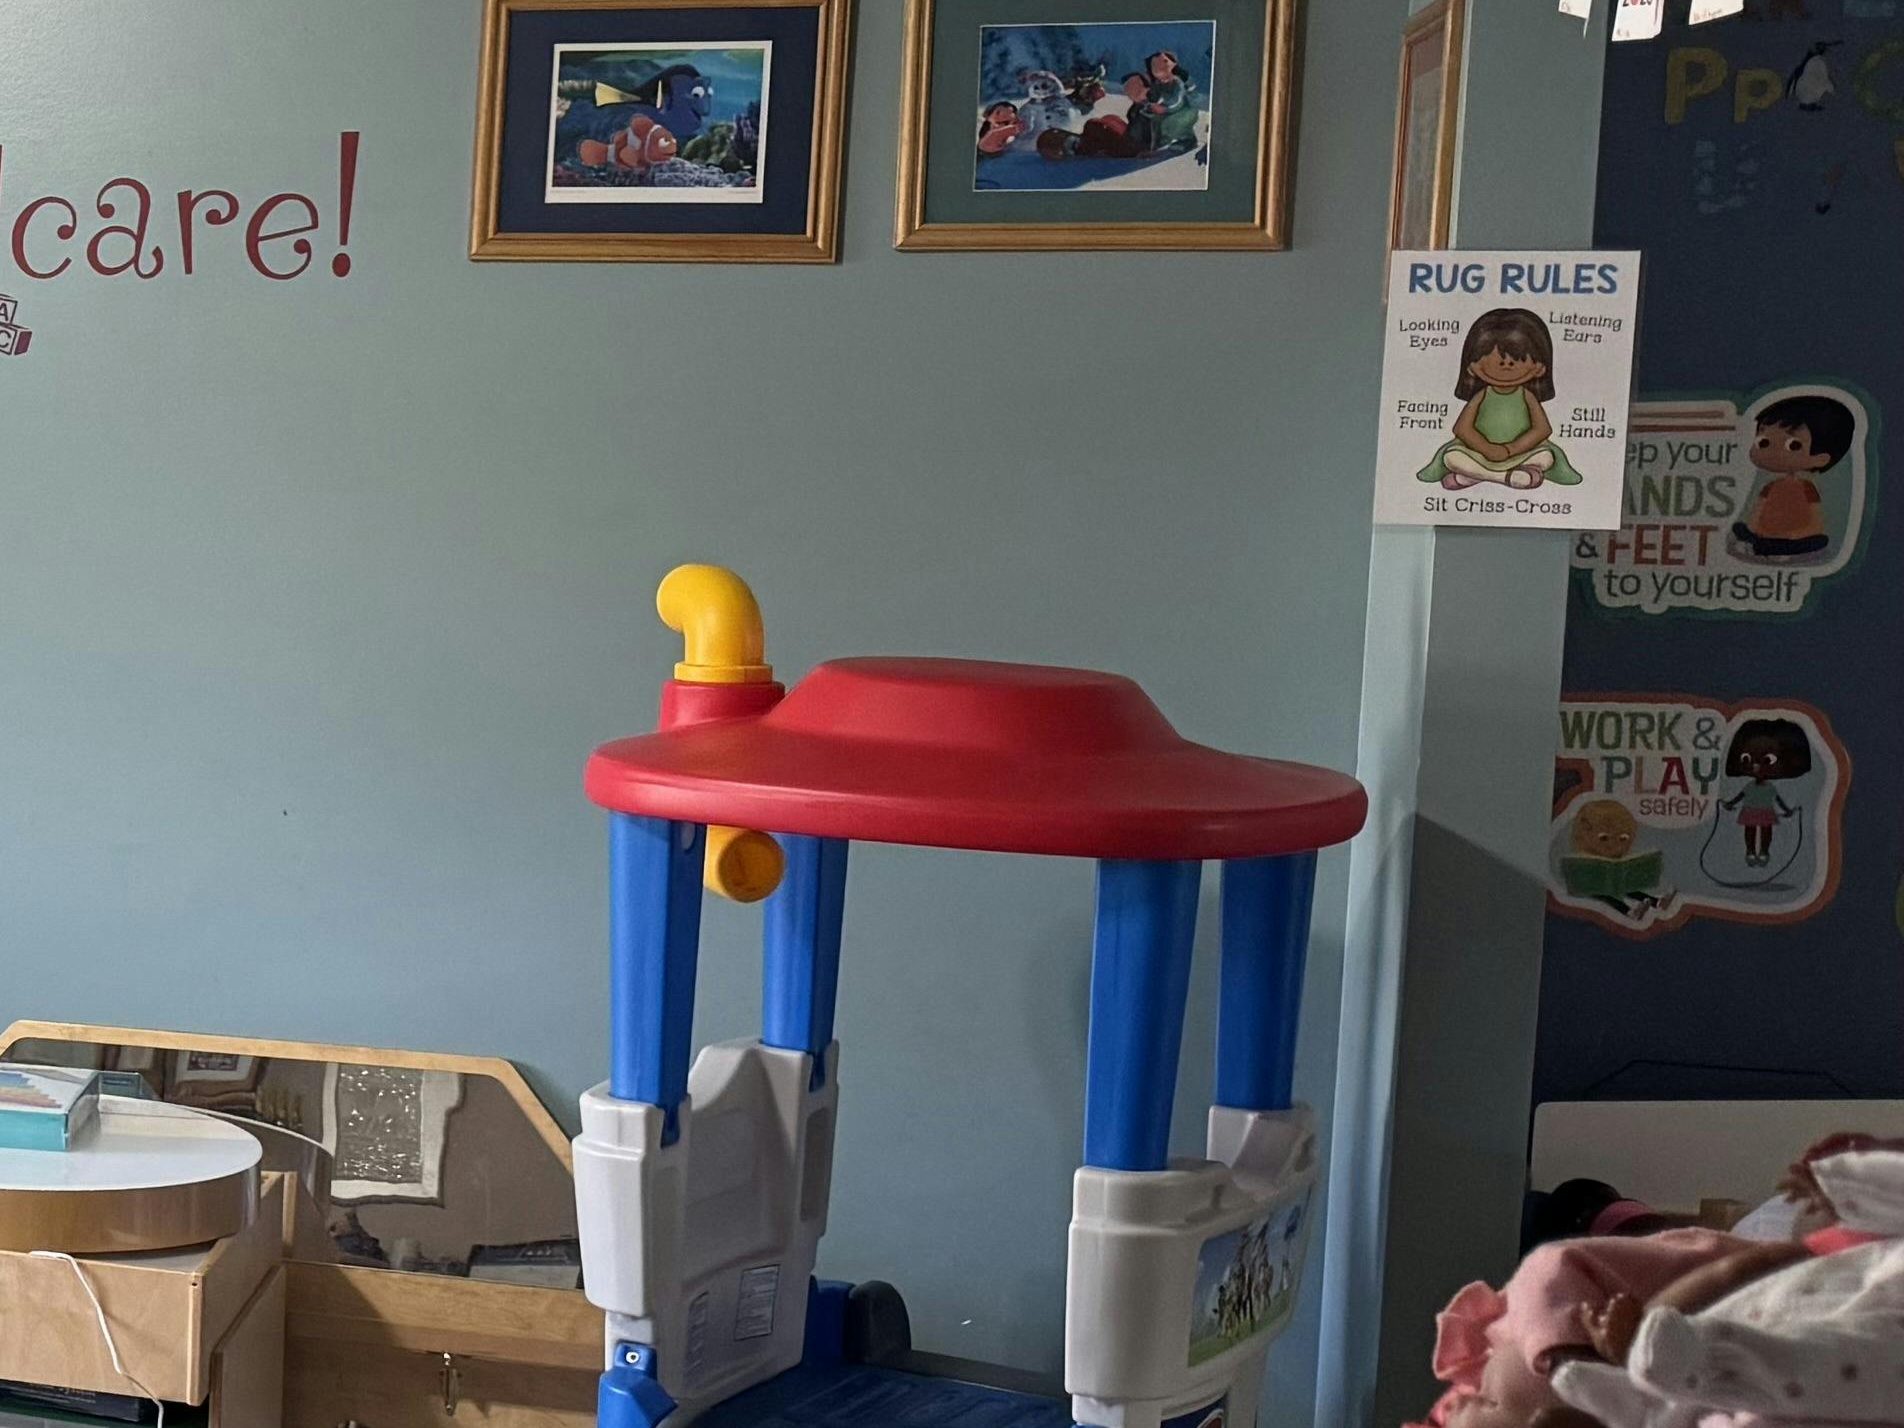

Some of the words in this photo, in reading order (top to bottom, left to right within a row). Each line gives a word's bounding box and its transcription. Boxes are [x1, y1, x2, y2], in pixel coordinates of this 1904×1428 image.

[1408, 262, 1486, 295] RUG
[1500, 262, 1619, 295] RULES
[1398, 317, 1461, 335] Looking
[1548, 310, 1623, 333] Listening
[1409, 334, 1449, 351] Eyes
[1563, 328, 1603, 344] Ears
[1397, 399, 1449, 417] Facing
[1571, 406, 1607, 422] Still
[1399, 415, 1445, 430] Front
[1558, 423, 1617, 440] Hands
[1667, 441, 1739, 469] your
[1423, 496, 1449, 514] Sit
[1455, 497, 1573, 515] Criss-Cross
[1575, 530, 1600, 560] &
[1606, 524, 1719, 567] FEET
[1603, 569, 1642, 598] to
[1651, 570, 1800, 605] yourself
[1558, 710, 1683, 751] WORK
[1692, 716, 1722, 751] &
[1600, 755, 1720, 795] PLAY
[1638, 797, 1709, 820] safely
